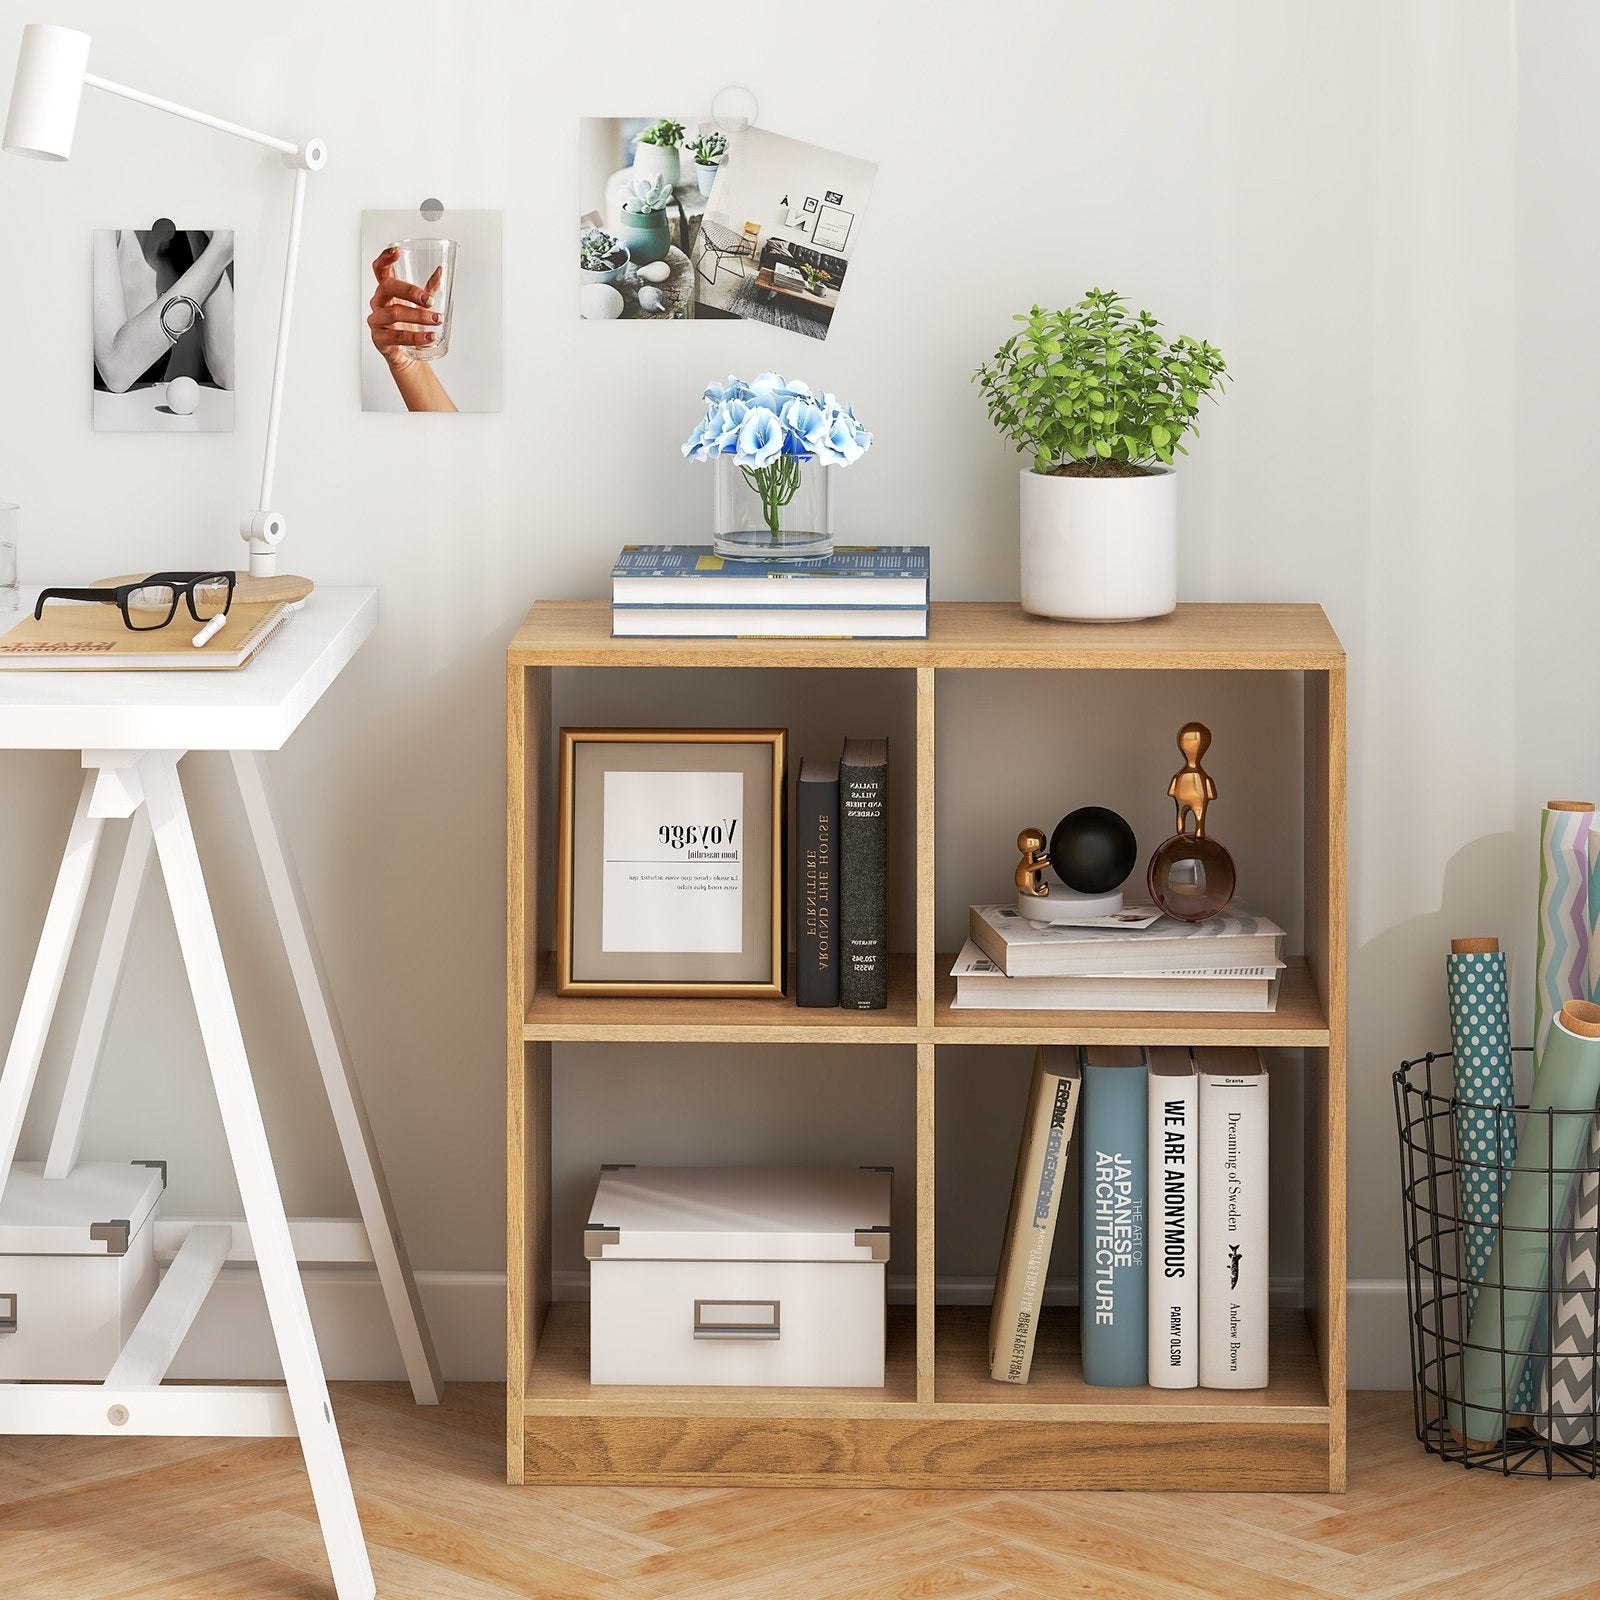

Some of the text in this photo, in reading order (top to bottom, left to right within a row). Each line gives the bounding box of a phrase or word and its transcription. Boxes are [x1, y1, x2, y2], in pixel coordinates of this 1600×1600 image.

[1114, 1153, 1132, 1268] JAPANESE
[1164, 1100, 1185, 1279] WE ARE ANONYMOUS
[1225, 1112, 1242, 1232] Dreaming of Sweden
[1095, 1151, 1114, 1326] ARCHITECTURE
[1133, 1199, 1143, 1266] THE ART OF
[1171, 1306, 1181, 1367] PARMY OLSON
[1230, 1303, 1241, 1372] Andrew Brown
